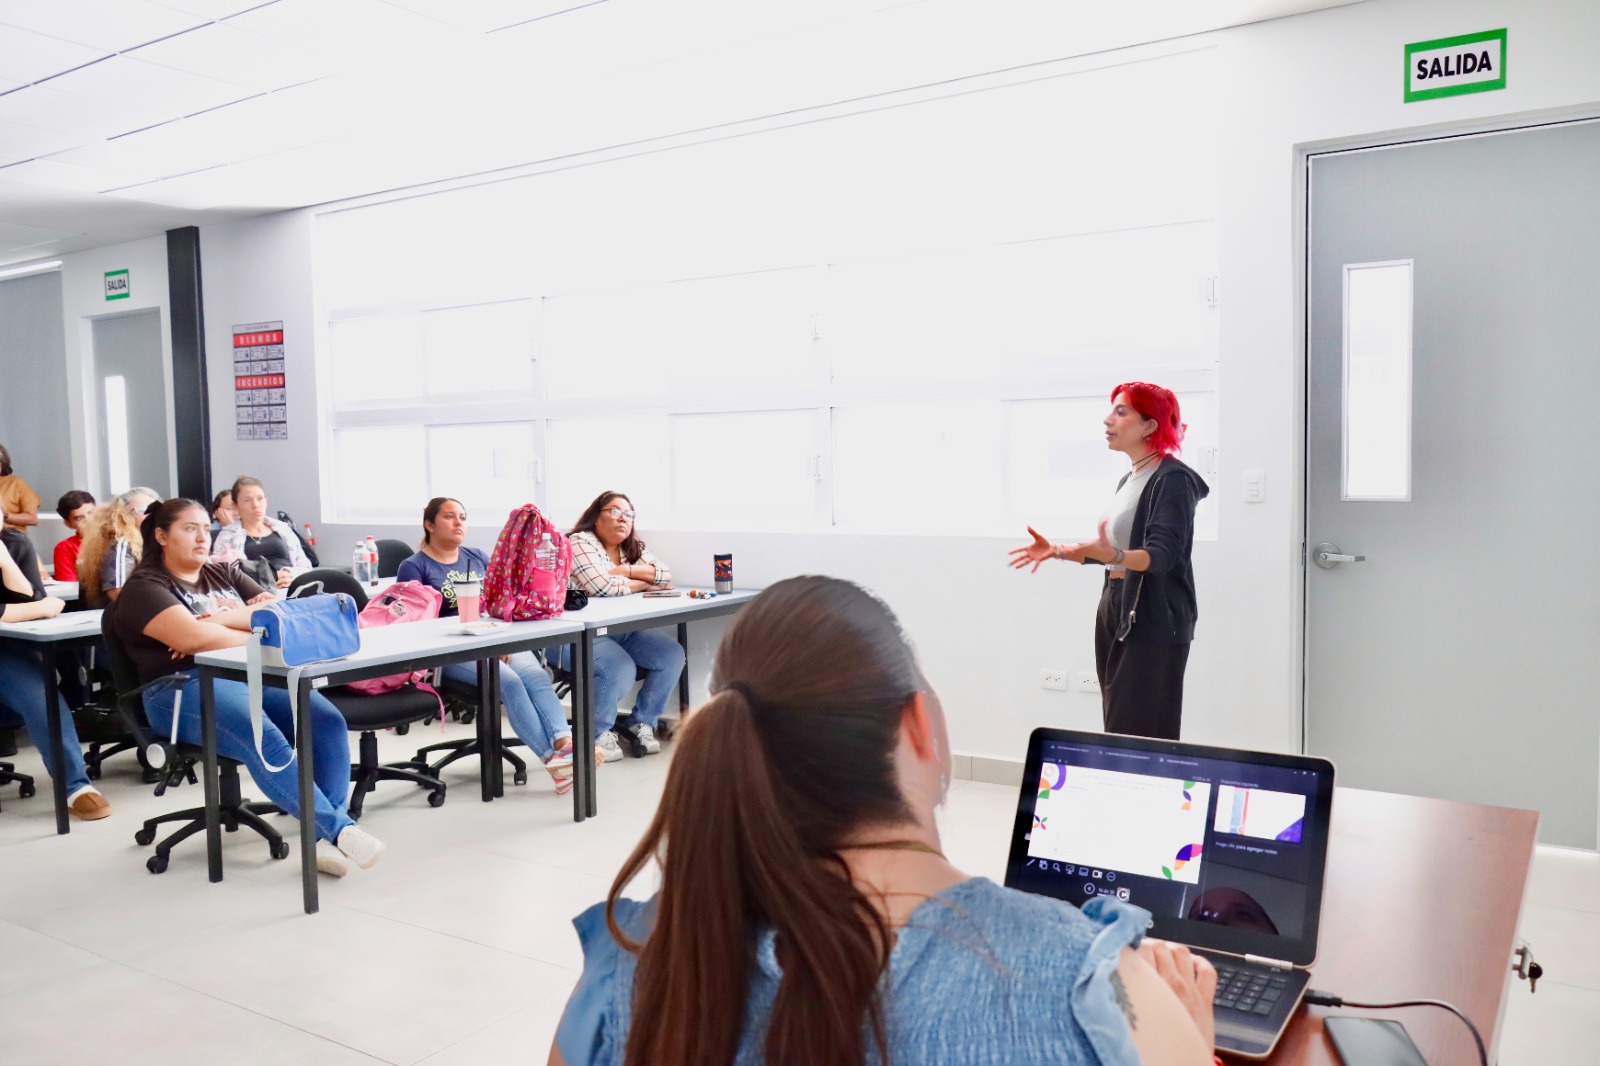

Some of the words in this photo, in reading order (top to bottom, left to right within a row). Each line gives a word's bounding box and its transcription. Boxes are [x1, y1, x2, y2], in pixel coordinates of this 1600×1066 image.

[1416, 50, 1492, 80] SALIDA
[107, 278, 127, 291] SALIDA
[239, 332, 279, 345] SISMOS
[237, 376, 284, 388] INCENDIOS
